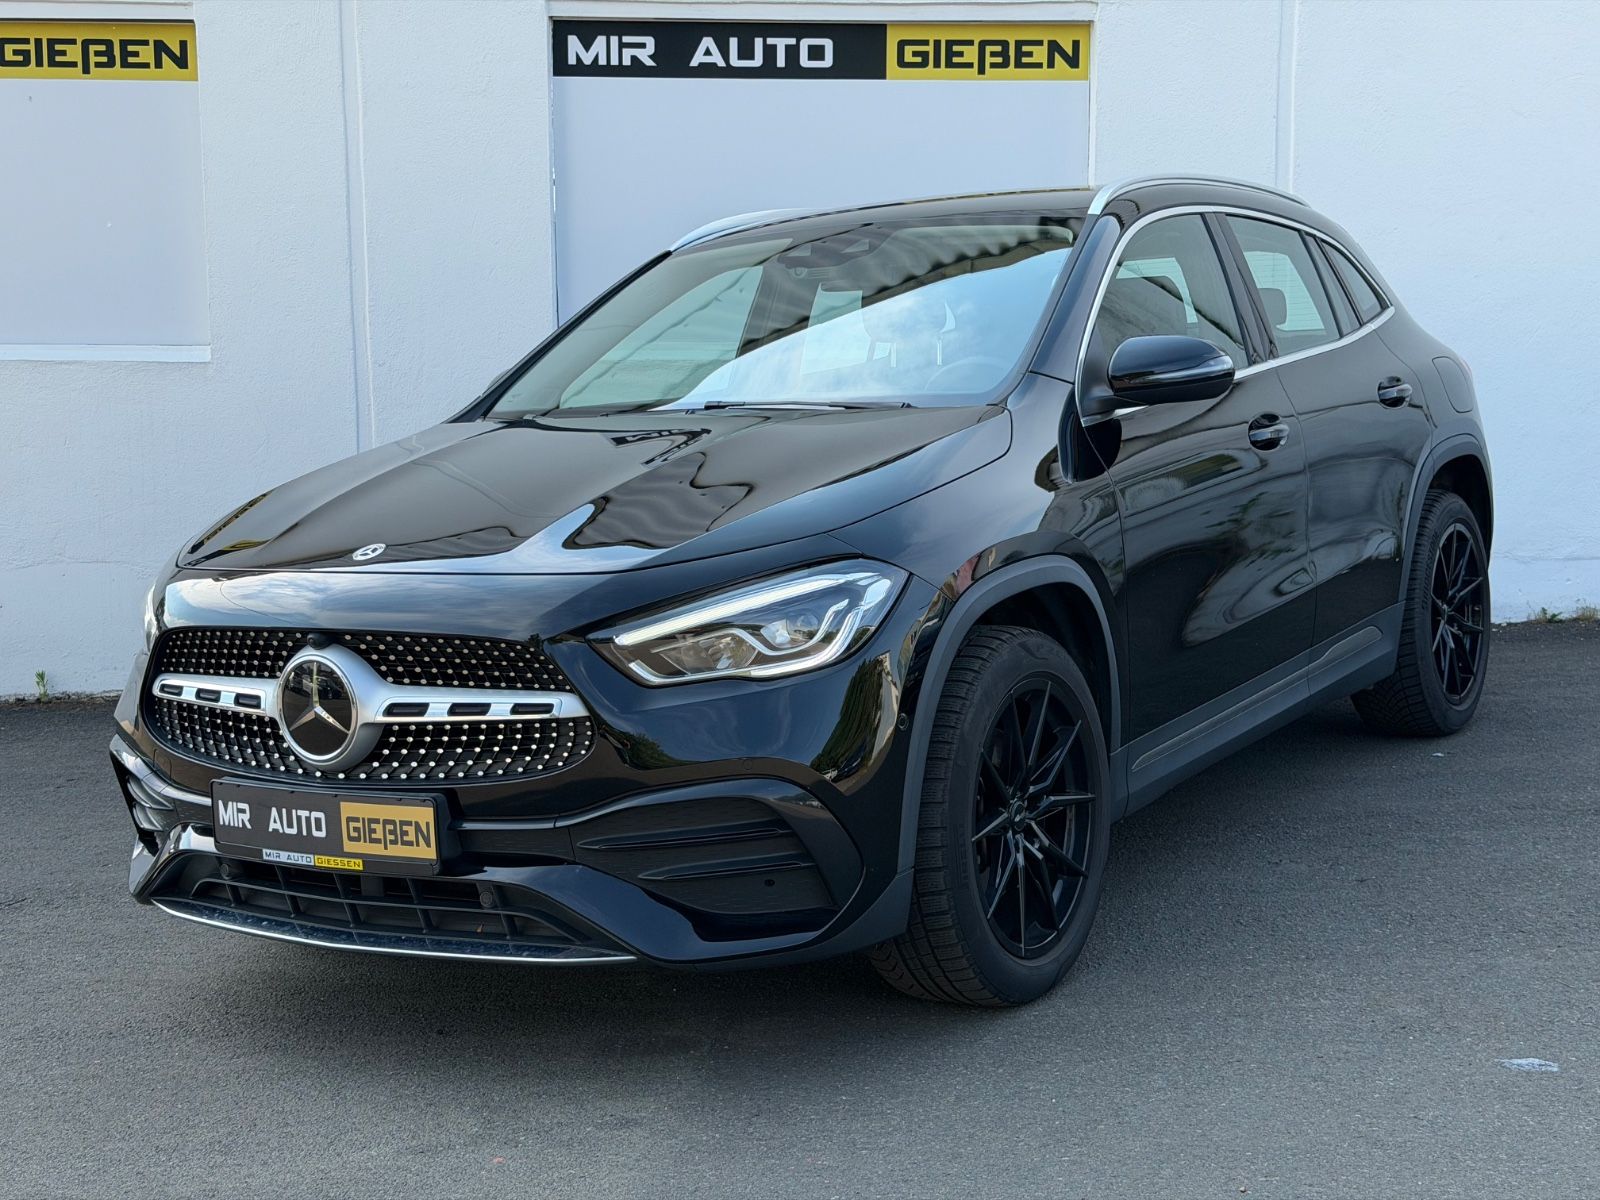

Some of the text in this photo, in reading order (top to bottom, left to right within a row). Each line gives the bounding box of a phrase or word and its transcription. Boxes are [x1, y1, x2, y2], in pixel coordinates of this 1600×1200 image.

[567, 34, 658, 67] MIR
[689, 36, 835, 69] AUTO
[217, 799, 252, 830] MIR
[268, 806, 327, 839] AUTO
[264, 850, 361, 869] MIR AUTO GIESSEN
